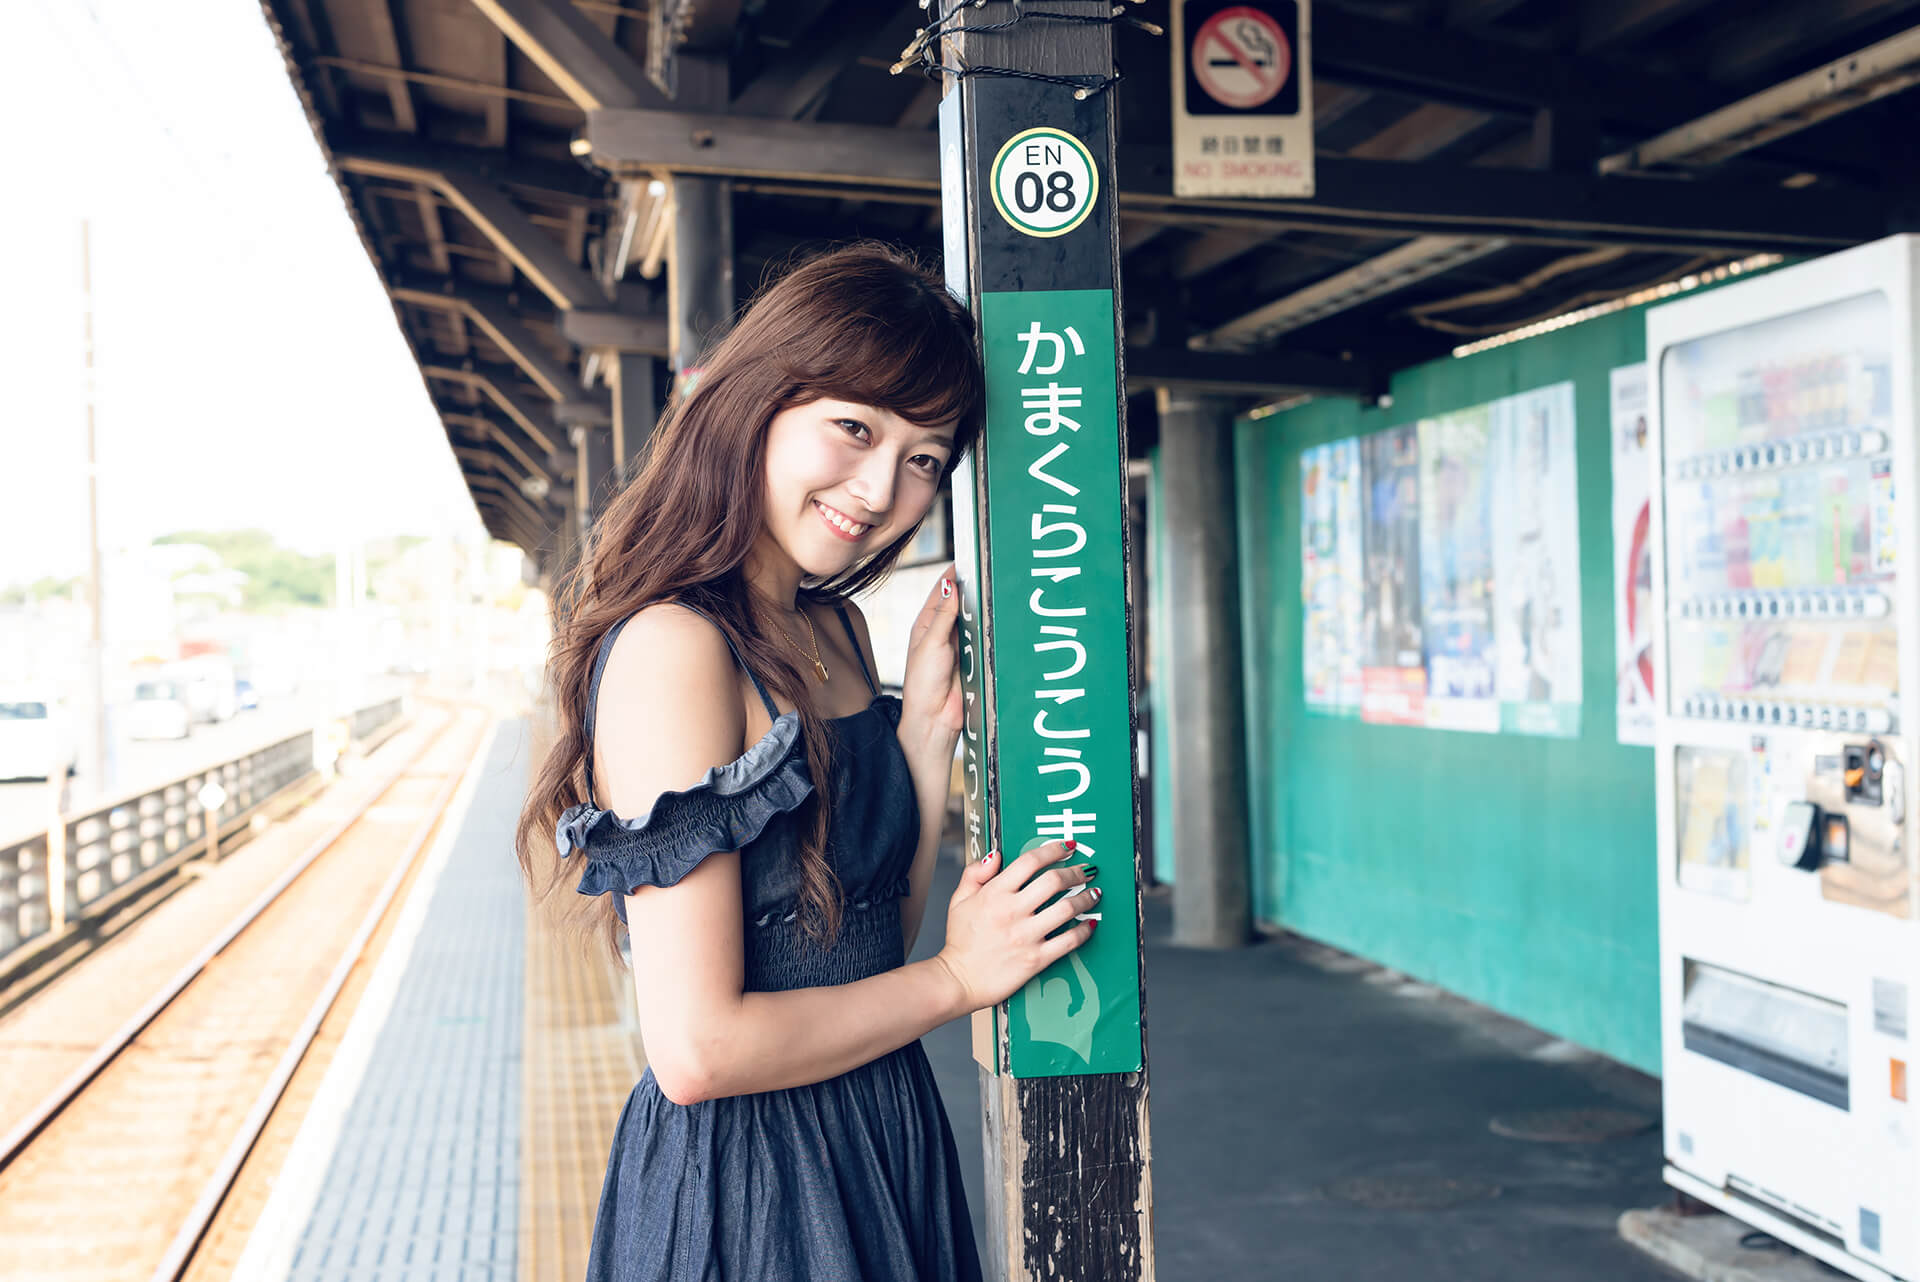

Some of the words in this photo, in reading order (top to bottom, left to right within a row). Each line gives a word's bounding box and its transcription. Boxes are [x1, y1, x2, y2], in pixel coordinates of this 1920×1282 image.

[1026, 145, 1062, 166] EN
[1184, 161, 1211, 177] NO
[1222, 160, 1304, 178] SMOKING
[1014, 170, 1076, 213] 08
